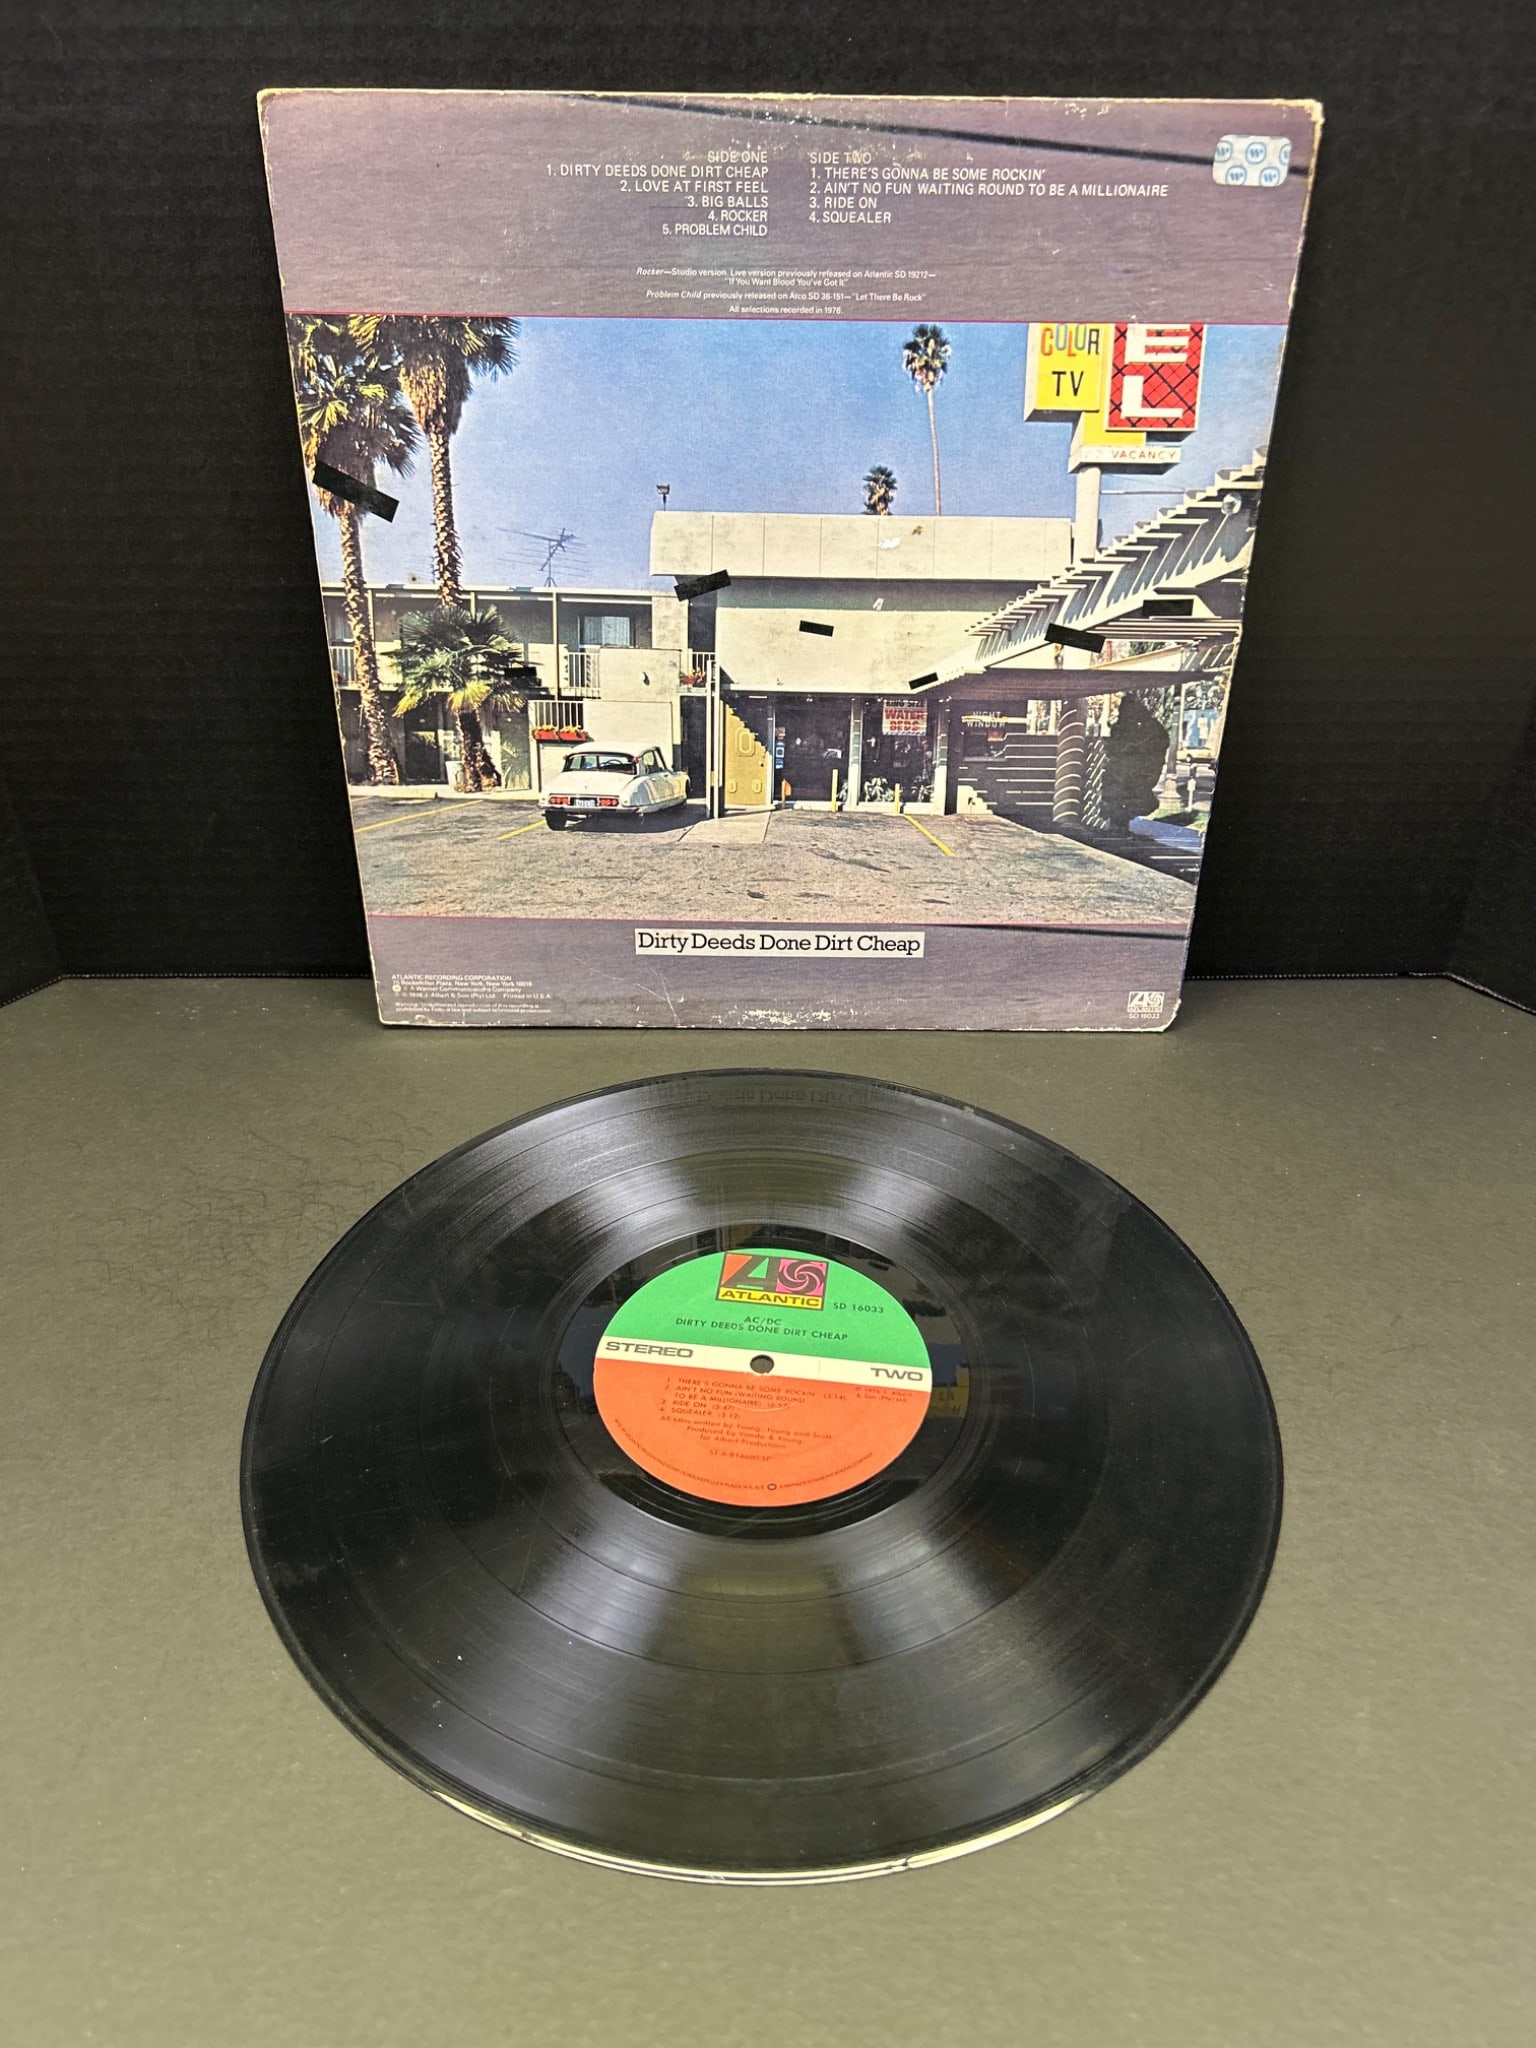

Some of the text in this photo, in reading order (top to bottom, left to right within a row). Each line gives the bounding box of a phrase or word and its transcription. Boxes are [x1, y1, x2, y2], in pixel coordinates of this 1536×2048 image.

[708, 151, 767, 163] SIDE ONE
[810, 152, 872, 165] SIDE TWO
[546, 165, 769, 179] 1. DIRTY DEEDS DONE DIRT CHEAP
[810, 167, 1046, 182] 1. THERE'S GONNA BE SOME ROCKIN'
[620, 180, 769, 194] 2. LOVE AT FIRST FEEL
[810, 182, 1169, 198] 2. AIN'T NO FUN WAITING ROUND TO BE A MILLIONAIRE
[687, 196, 769, 209] 3. BIG BALLS
[809, 197, 878, 210] 3. RIDE ON
[708, 210, 768, 222] 4. ROCKER
[809, 212, 892, 224] 4. SQUEALER
[662, 224, 768, 237] 5. PROBLEM CHILD
[730, 268, 747, 277] Live
[748, 269, 776, 278] version
[778, 268, 817, 279] previously
[819, 270, 852, 278] released
[864, 270, 894, 279] Atlantic
[894, 270, 906, 279] SD
[736, 278, 750, 286] You
[751, 278, 772, 286] Want
[772, 278, 795, 286] Blood
[796, 278, 822, 287] You've
[823, 279, 838, 287] Got
[646, 290, 680, 299] Problem
[681, 290, 702, 299] Child
[703, 291, 743, 300] previously
[744, 292, 776, 300] released
[808, 292, 820, 300] SD
[870, 293, 891, 301] There
[892, 293, 903, 301] Be
[728, 305, 740, 313] All
[741, 306, 779, 314] selections
[780, 306, 815, 314] recorded
[816, 306, 823, 314] in
[1041, 324, 1100, 357] COLOR
[1052, 371, 1084, 397] TV
[1111, 450, 1177, 460] VACANCY
[884, 709, 925, 720] WATER
[638, 932, 921, 956] Dirty Deeds Done Dirt Cheap
[721, 1290, 820, 1307] ATLANTIC
[833, 1302, 884, 1314] SD 16033
[744, 1316, 782, 1326] AC/DC
[676, 1318, 849, 1341] DIRTY DEEDS DONE DIRT CHEAP
[604, 1340, 694, 1359] STEREO
[870, 1367, 923, 1382] TWO
[672, 1407, 713, 1416] SQUEALER
